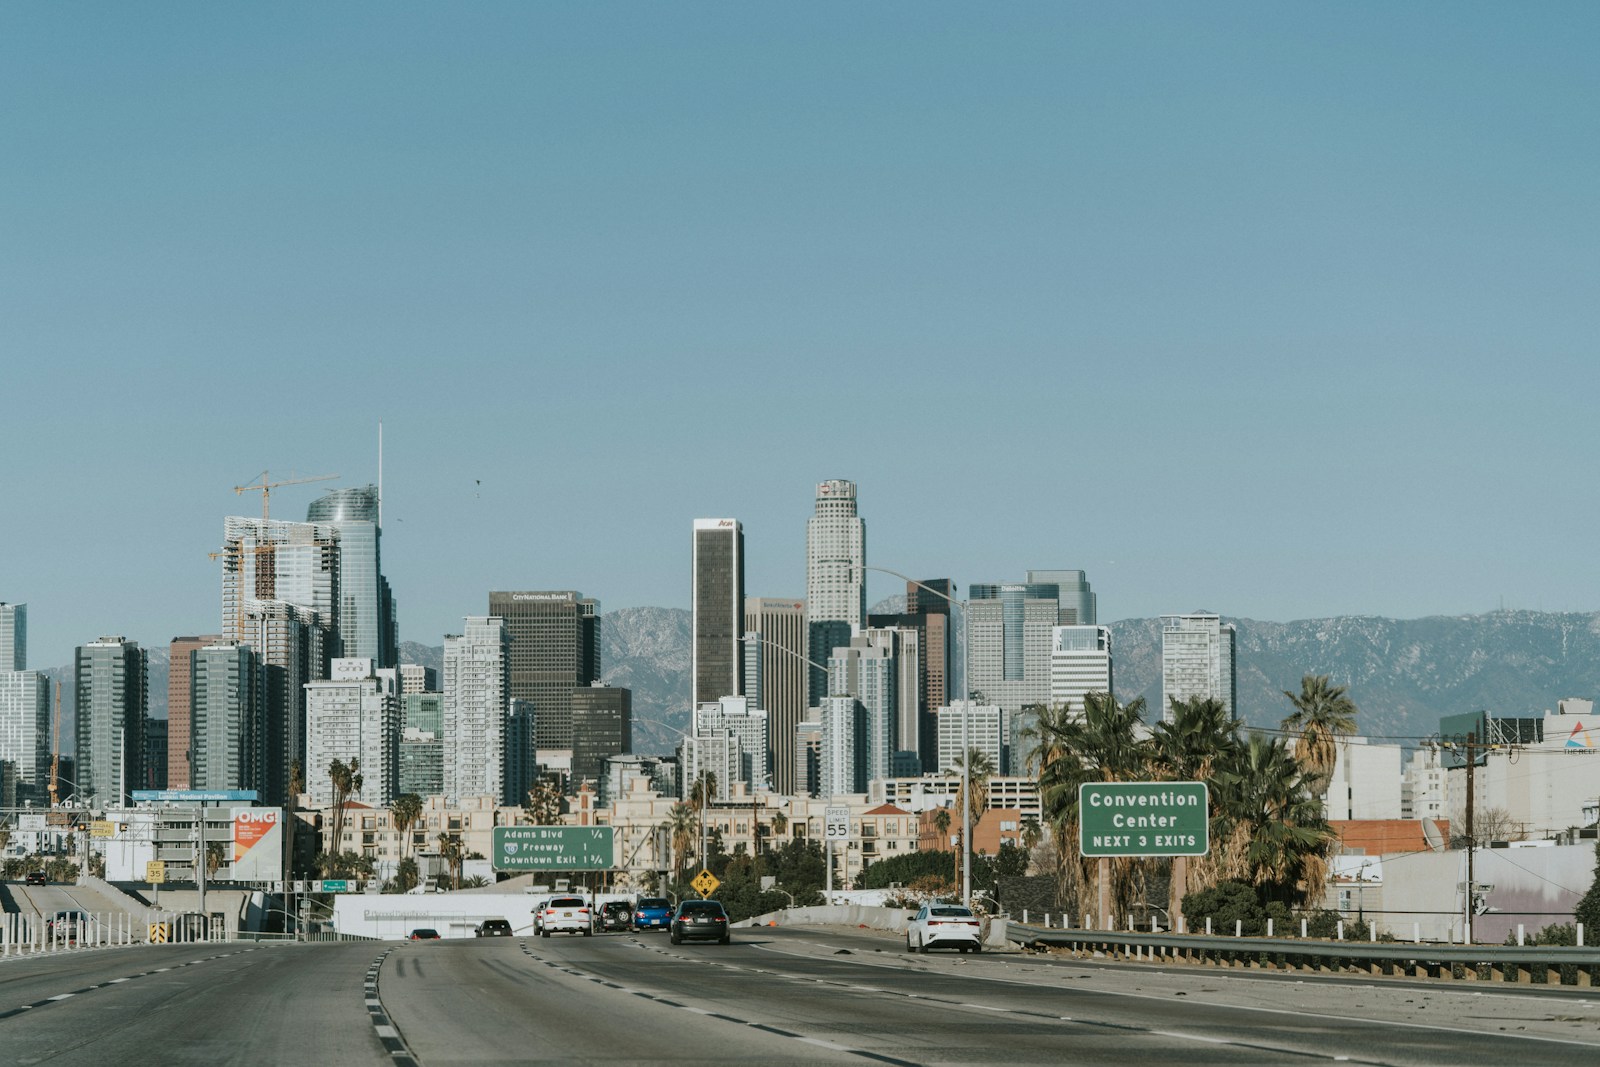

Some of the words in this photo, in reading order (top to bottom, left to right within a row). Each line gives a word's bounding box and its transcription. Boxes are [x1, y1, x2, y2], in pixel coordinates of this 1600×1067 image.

[1089, 792, 1198, 807] Convention
[238, 811, 278, 823] OMG!
[1112, 813, 1178, 828] Center
[504, 830, 537, 838] Adams
[541, 830, 563, 838] Blvd
[827, 824, 847, 836] 55
[1093, 836, 1131, 847] NEXT
[1139, 836, 1147, 847] 3
[1155, 835, 1196, 847] EXITS
[523, 843, 564, 853] Freeway
[583, 843, 587, 851] 1
[504, 856, 552, 864] Downtown
[556, 856, 577, 864] Exit
[583, 856, 587, 864] 1
[150, 870, 161, 878] 35
